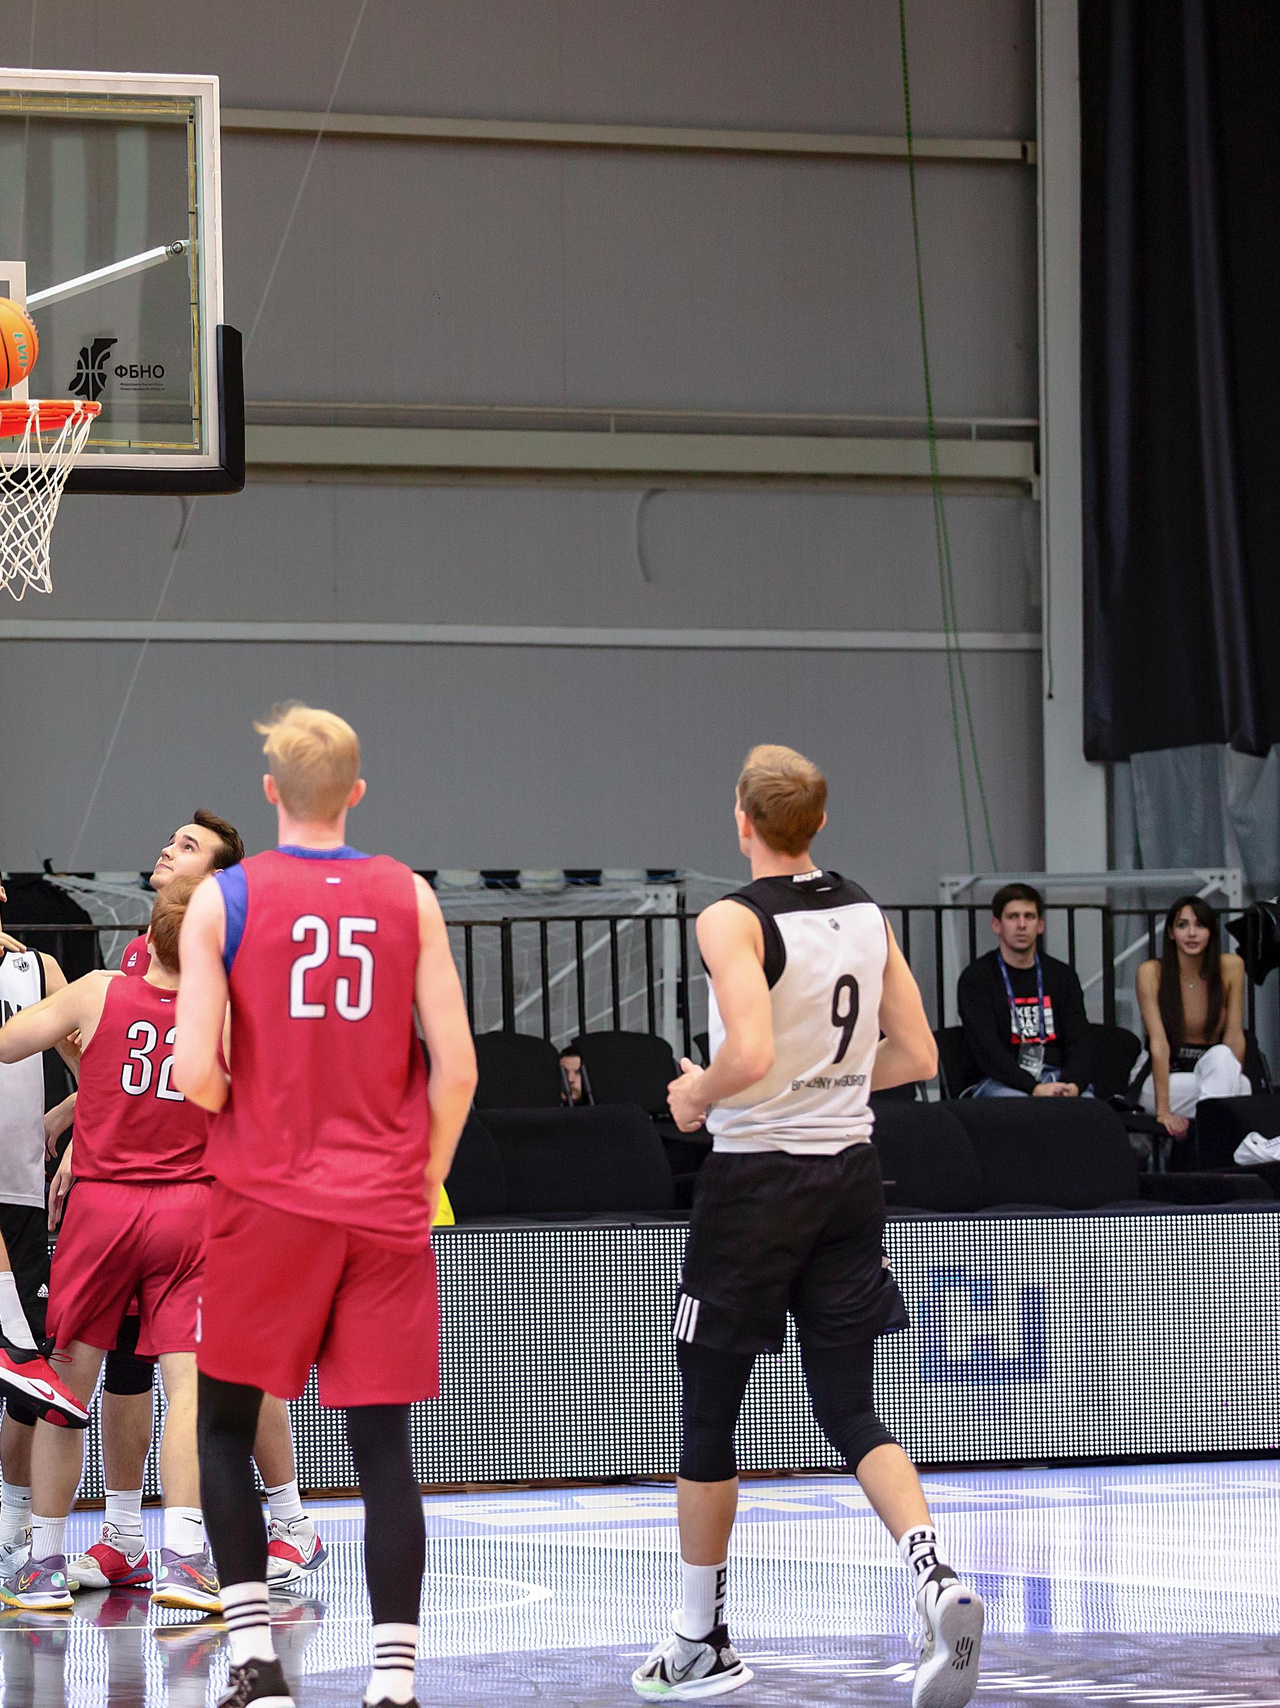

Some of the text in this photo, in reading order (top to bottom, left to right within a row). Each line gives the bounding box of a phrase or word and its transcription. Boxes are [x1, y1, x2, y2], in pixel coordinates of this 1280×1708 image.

[114, 364, 165, 378] ФБНО
[288, 913, 378, 1023] 25
[120, 1019, 186, 1102] 32
[832, 974, 860, 1064] 9
